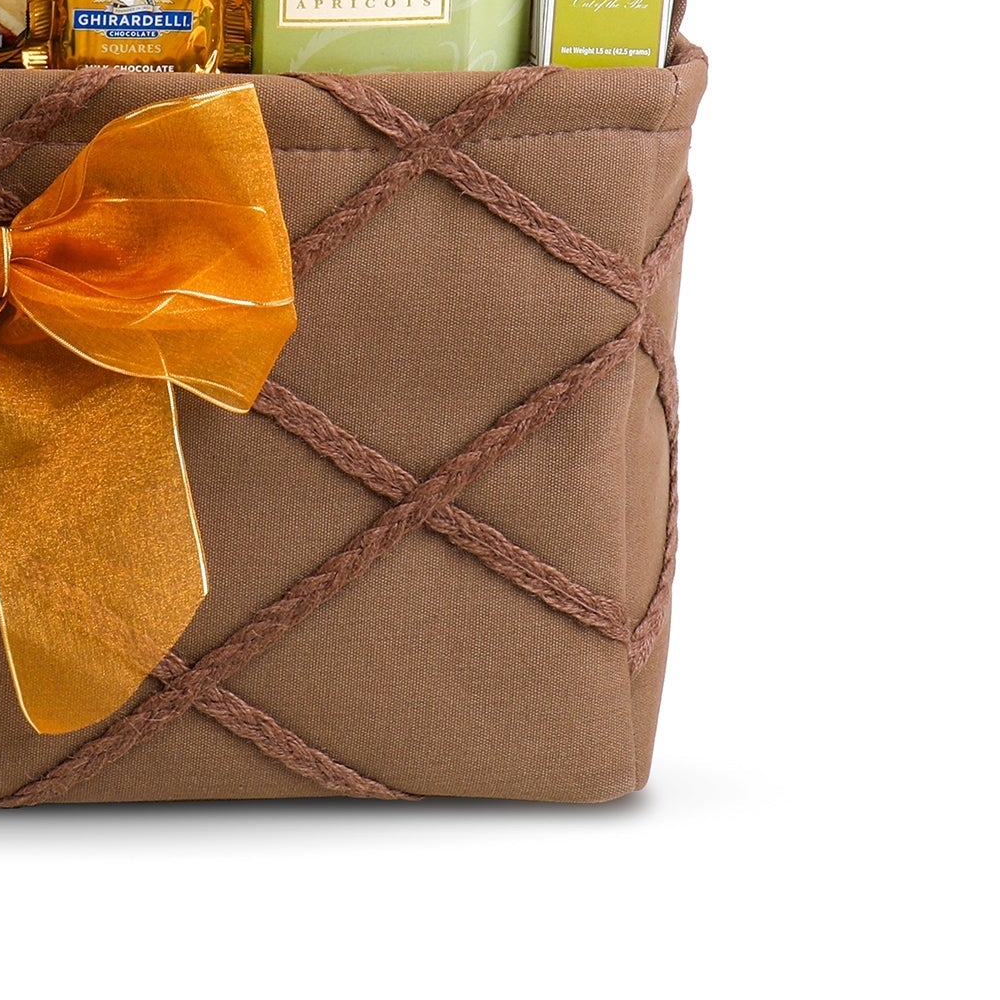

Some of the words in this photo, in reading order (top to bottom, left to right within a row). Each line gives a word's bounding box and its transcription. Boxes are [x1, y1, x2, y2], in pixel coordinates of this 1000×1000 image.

[101, 44, 162, 55] SQUARES
[561, 46, 572, 54] Net
[573, 46, 595, 55] Weight
